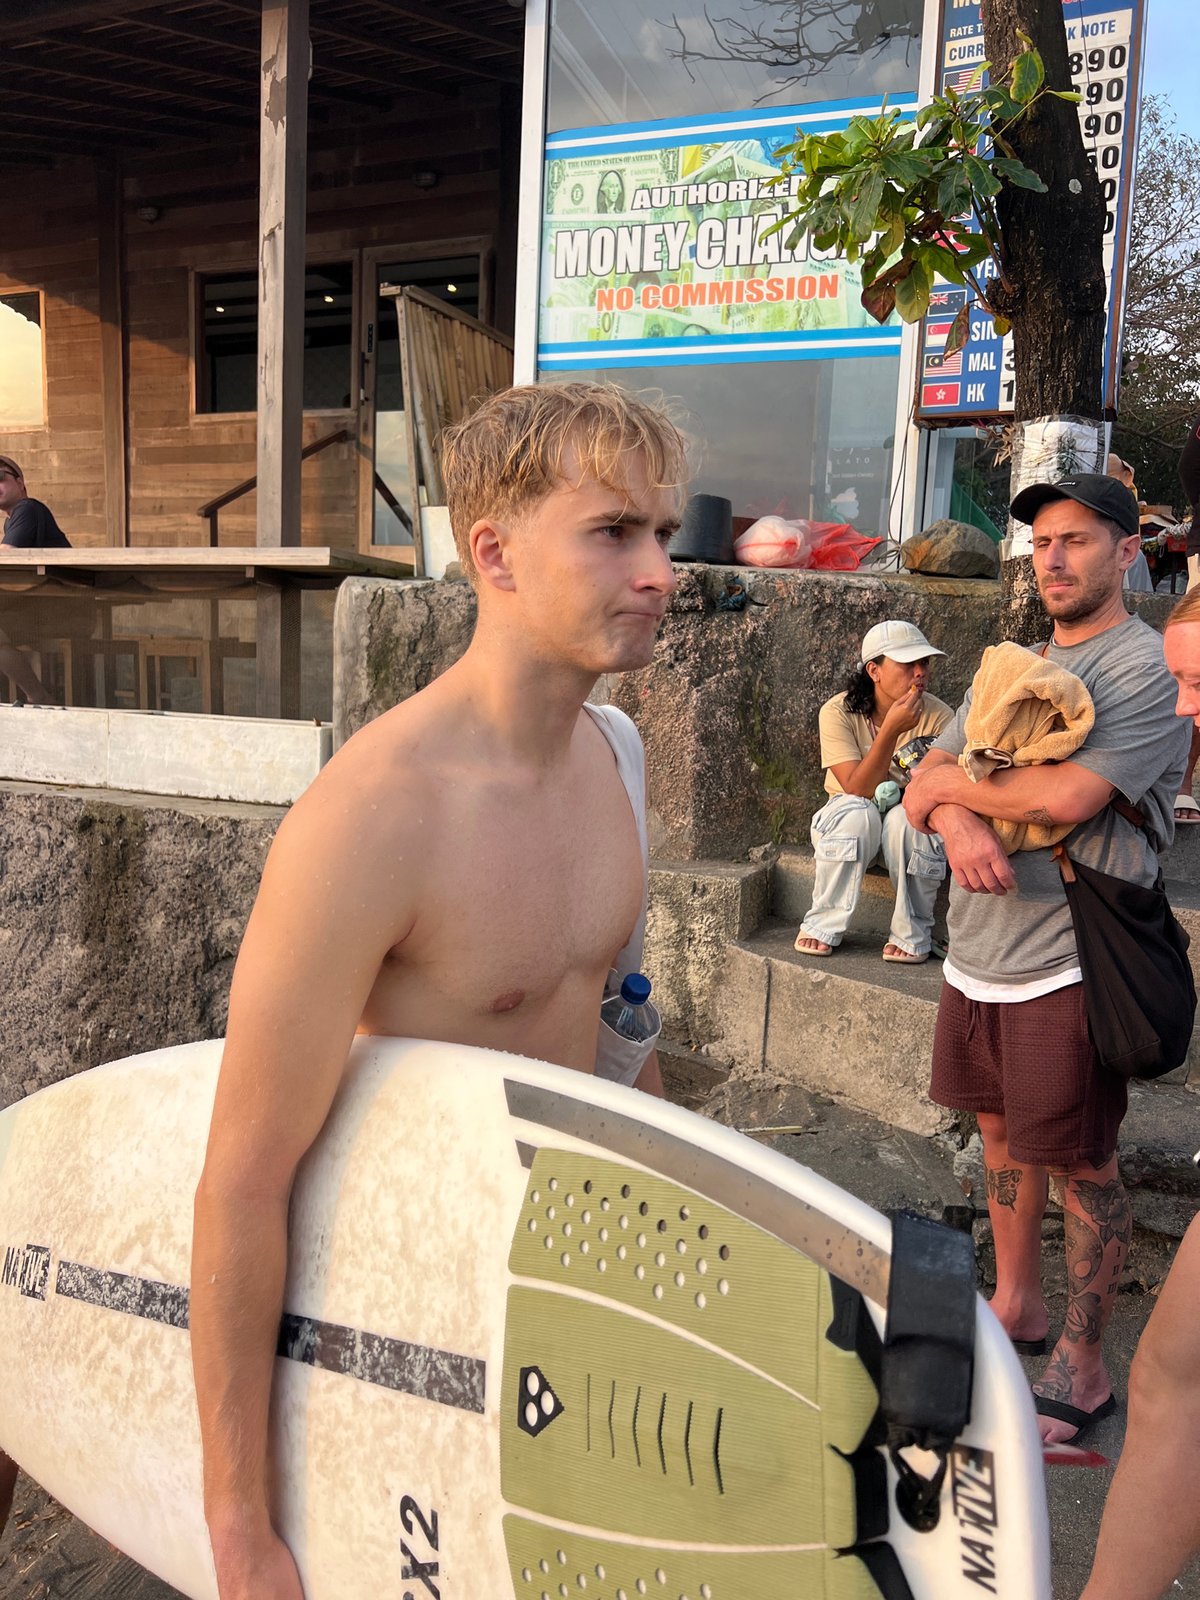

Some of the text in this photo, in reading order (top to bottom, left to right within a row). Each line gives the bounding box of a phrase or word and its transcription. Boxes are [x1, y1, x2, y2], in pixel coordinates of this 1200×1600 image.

[950, 24, 974, 38] RATE
[1081, 20, 1116, 38] NOTE
[554, 221, 691, 279] MONEY
[596, 287, 634, 312] NO
[641, 274, 839, 310] COMMISSION
[968, 351, 996, 372] MAL
[967, 382, 986, 402] HK
[952, 1447, 998, 1594] NATIVE
[400, 1495, 440, 1600] X2
